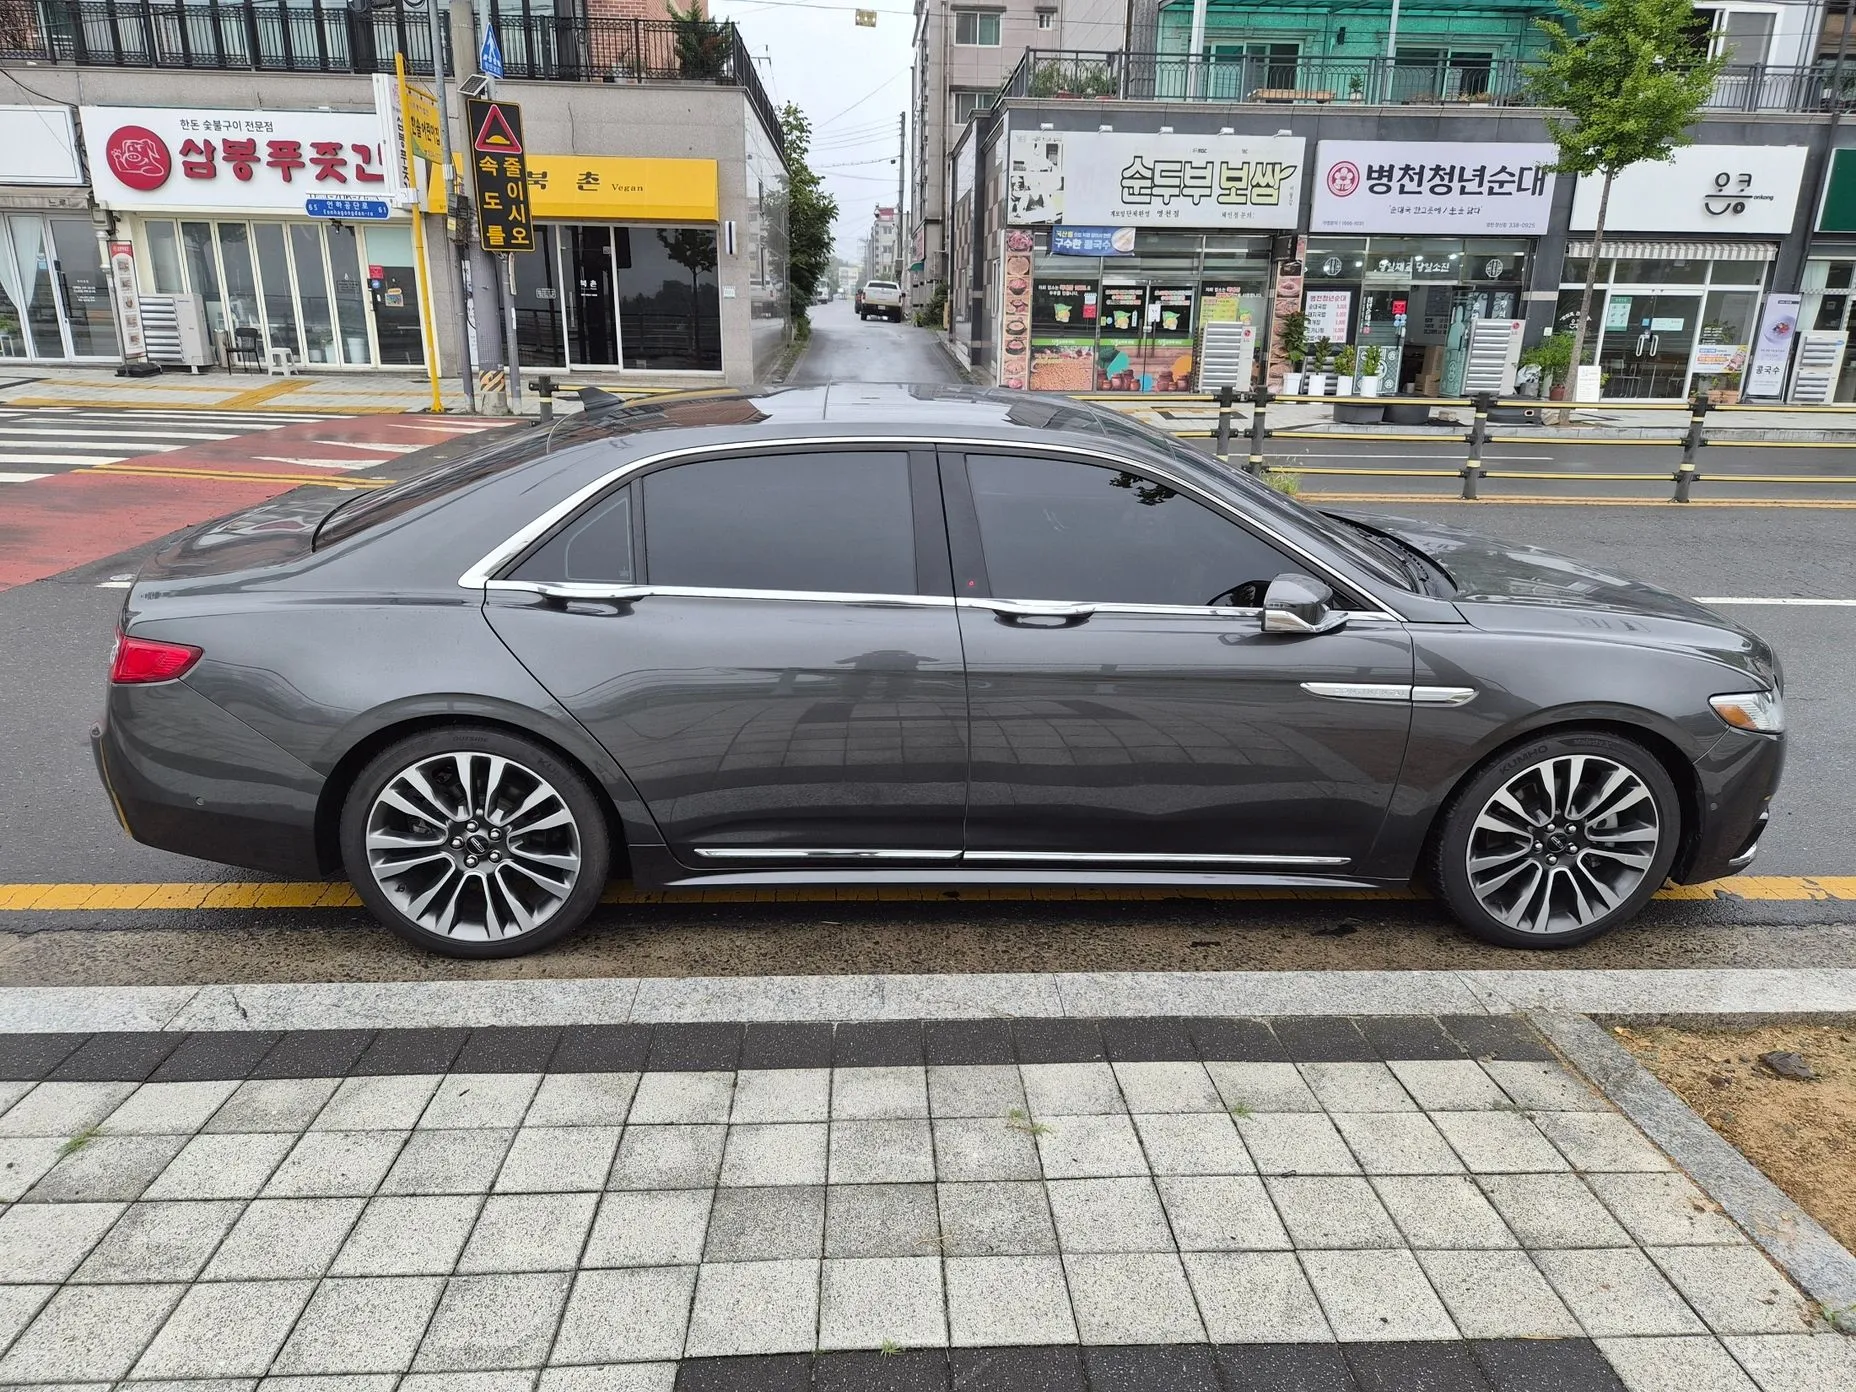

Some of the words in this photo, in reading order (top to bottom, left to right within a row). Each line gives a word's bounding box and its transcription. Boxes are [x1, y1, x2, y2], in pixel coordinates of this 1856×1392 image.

[179, 118, 200, 131] 한돈
[203, 119, 242, 132] 숯불구이
[245, 121, 274, 133] 전문점
[611, 183, 644, 193] Vegan
[1121, 155, 1215, 206] 순두부
[1217, 160, 1298, 206] 보쌈
[1366, 164, 1546, 197] 병천청년순대
[479, 155, 506, 245] 속도를
[503, 157, 530, 244] 줄이시오
[1055, 238, 1082, 250] 구수한
[1416, 262, 1450, 273] 당일소진
[1756, 365, 1780, 375] 콩국수
[1500, 745, 1549, 775] KUMHO
